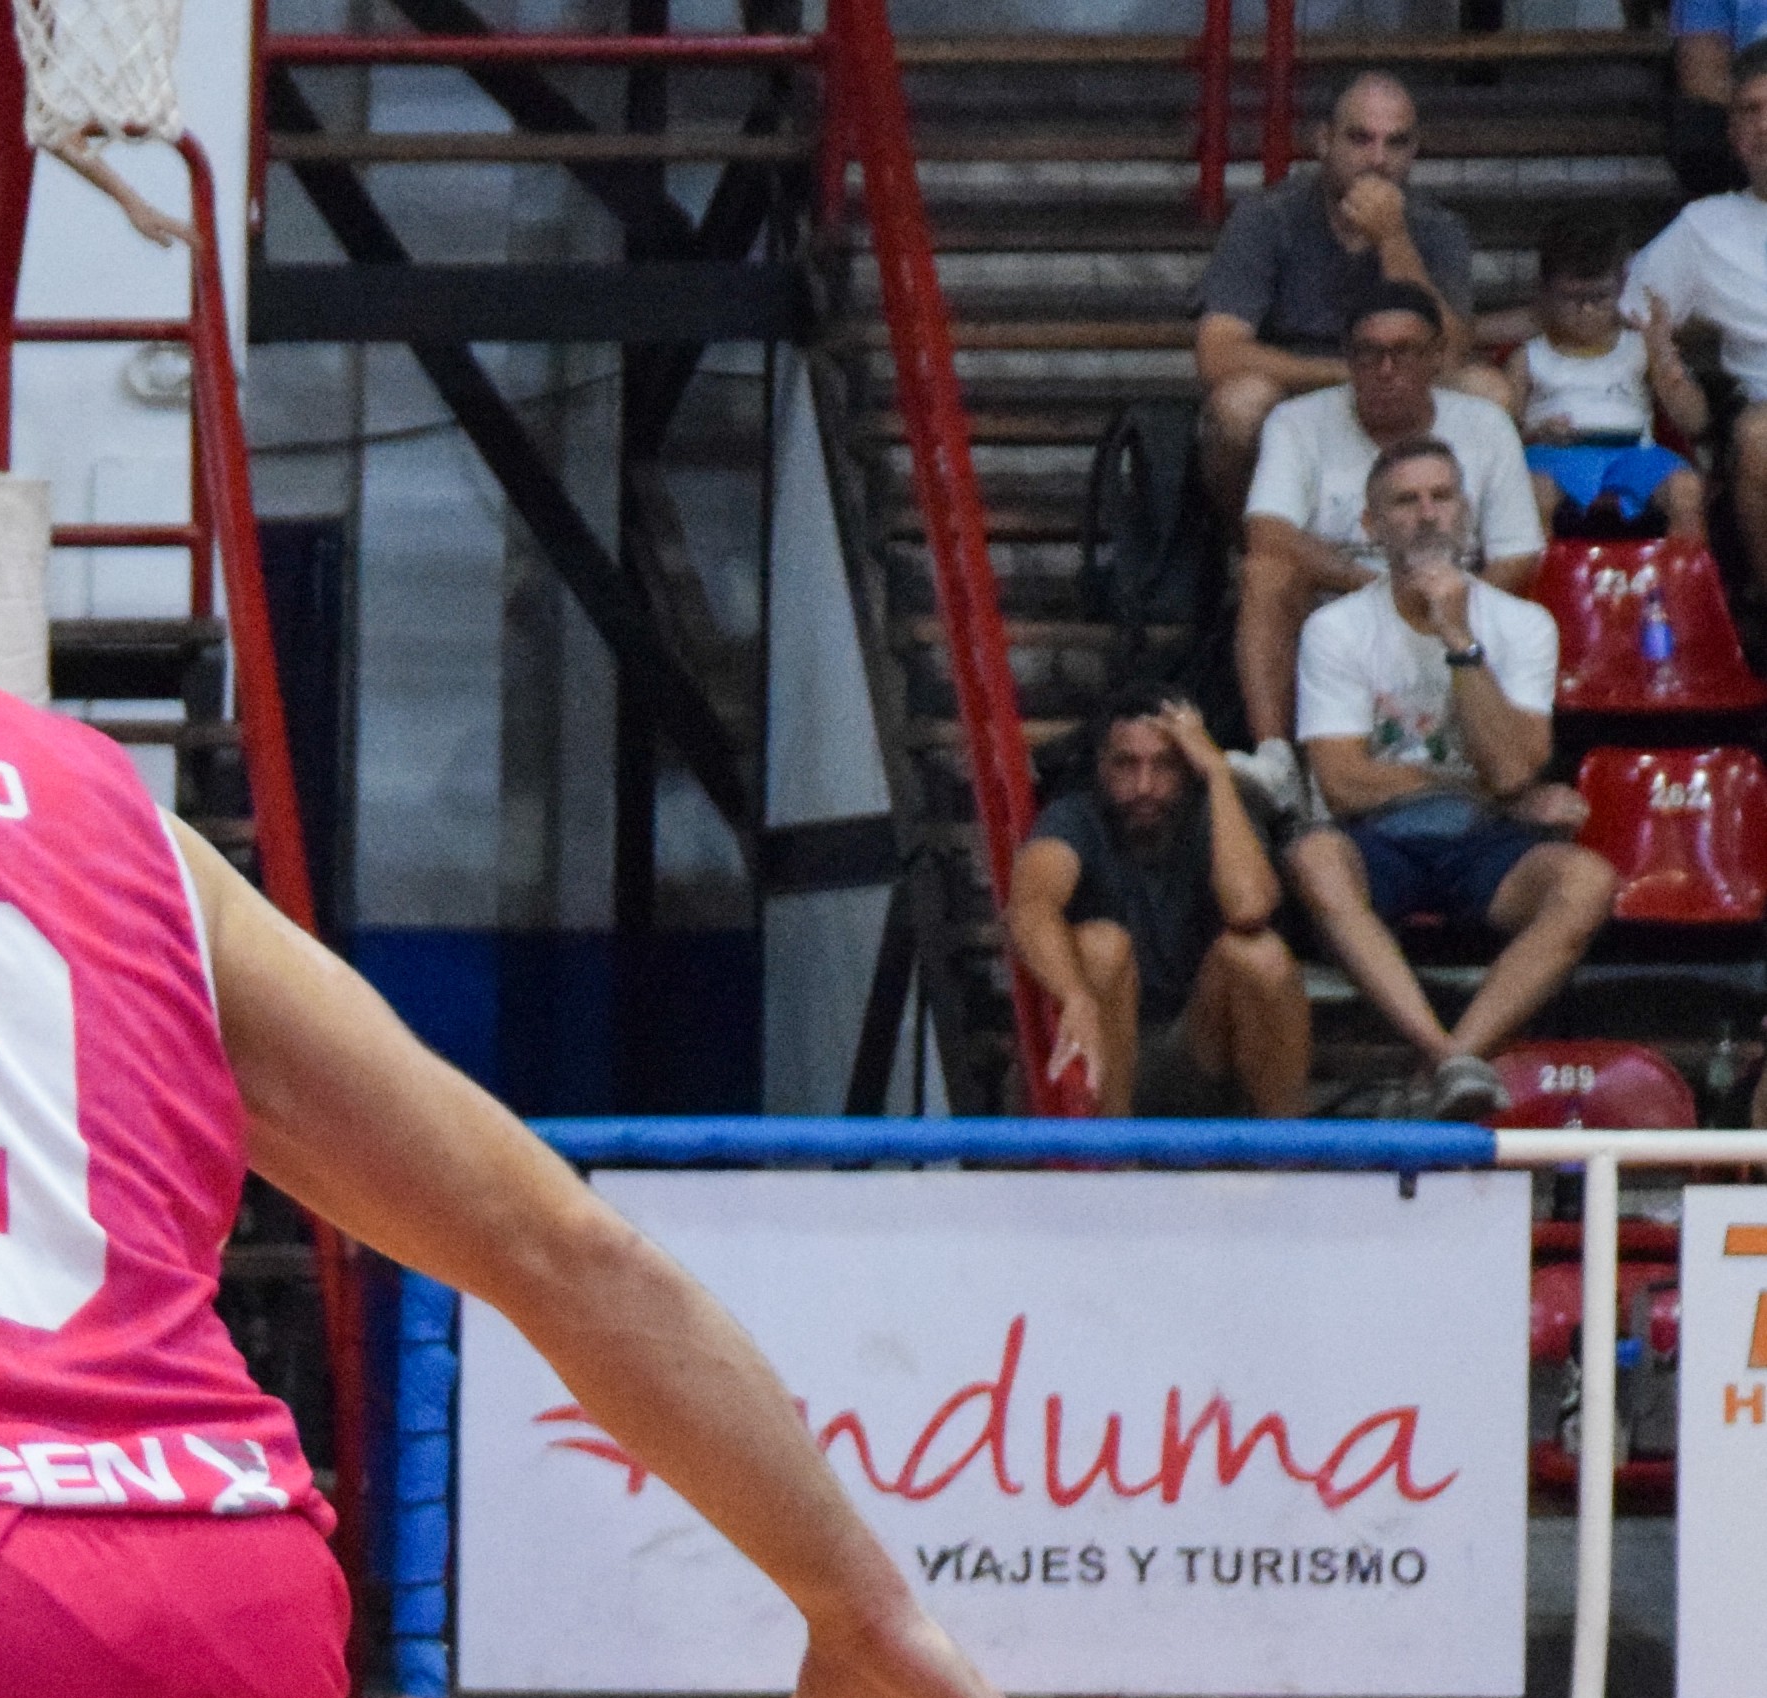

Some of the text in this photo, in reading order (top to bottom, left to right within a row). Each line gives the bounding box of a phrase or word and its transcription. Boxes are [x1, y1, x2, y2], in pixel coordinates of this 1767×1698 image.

[797, 1314, 1461, 1510] nduma
[916, 1544, 1429, 1588] VIAJES Y TURISMO
